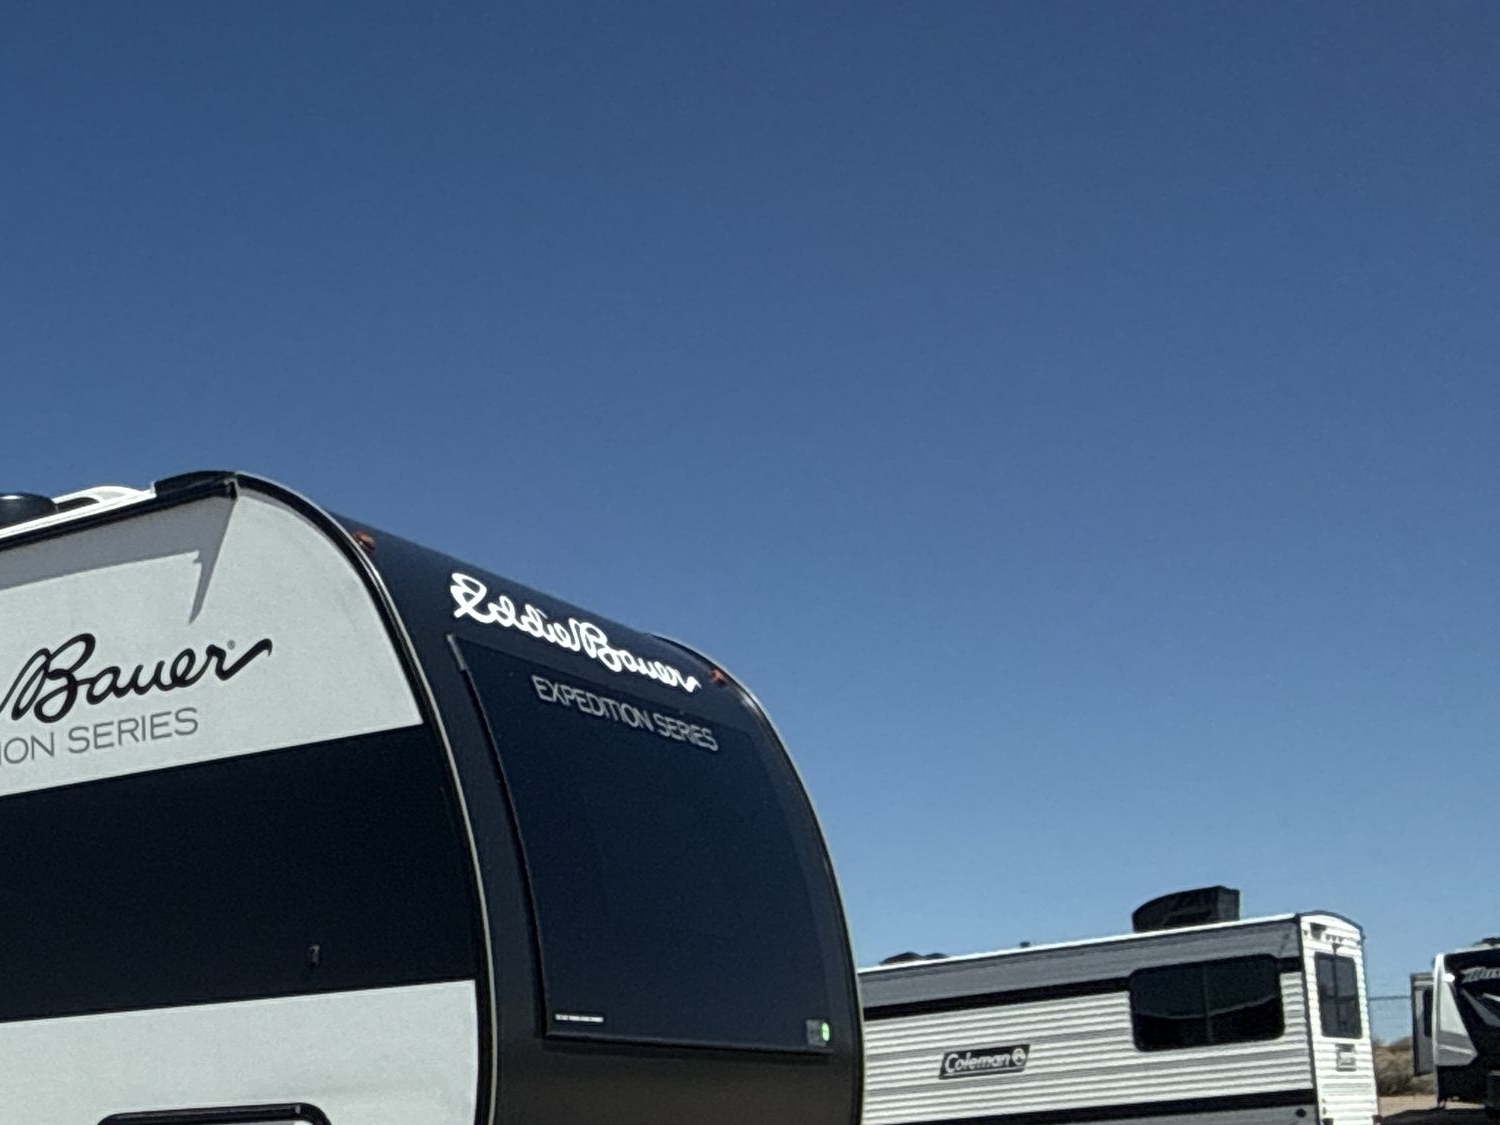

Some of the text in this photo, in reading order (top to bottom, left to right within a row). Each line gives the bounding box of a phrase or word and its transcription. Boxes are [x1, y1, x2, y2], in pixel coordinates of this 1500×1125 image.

[450, 572, 701, 693] Eddie Bauer
[67, 706, 199, 754] SERIES
[530, 674, 719, 752] EXPEDITION SERIES
[944, 1051, 1011, 1074] Coleman
